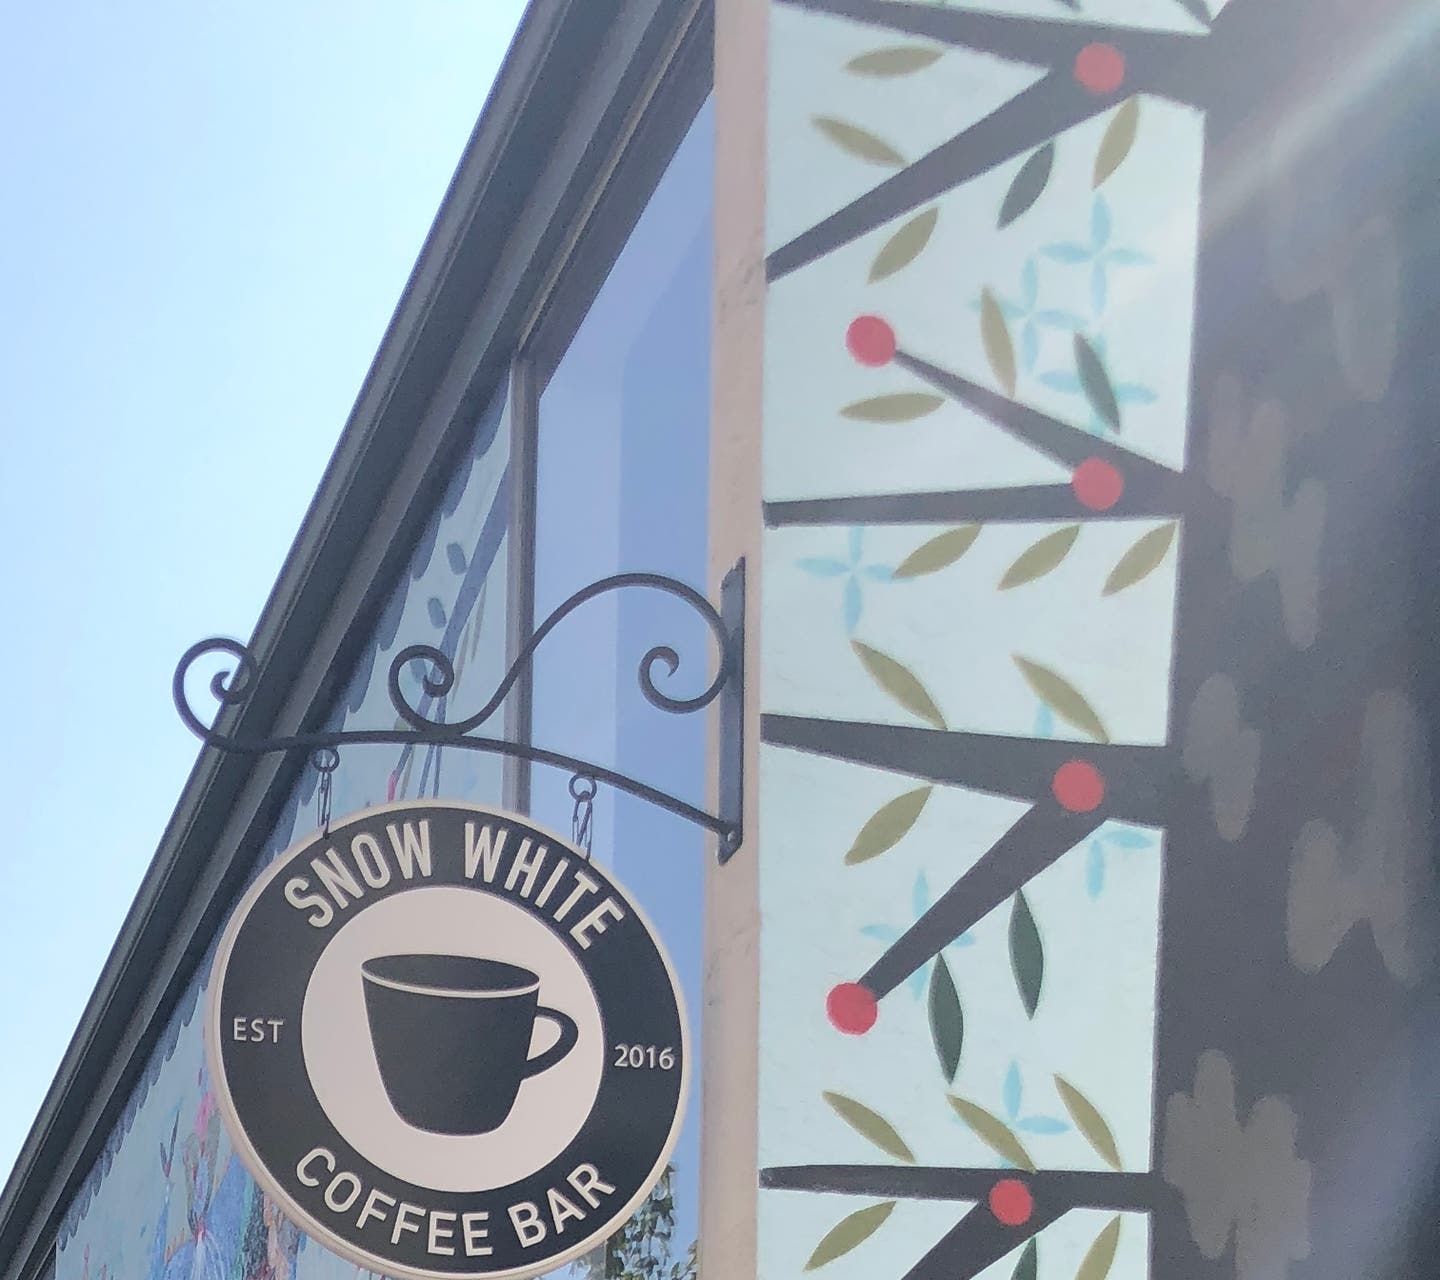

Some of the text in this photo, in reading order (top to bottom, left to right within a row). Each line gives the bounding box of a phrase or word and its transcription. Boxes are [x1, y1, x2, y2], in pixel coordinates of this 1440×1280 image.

[284, 819, 625, 950] SNOW WHITE
[233, 1017, 285, 1044] EST
[613, 1043, 677, 1071] 2016
[295, 1147, 617, 1257] COFFEE BAR
